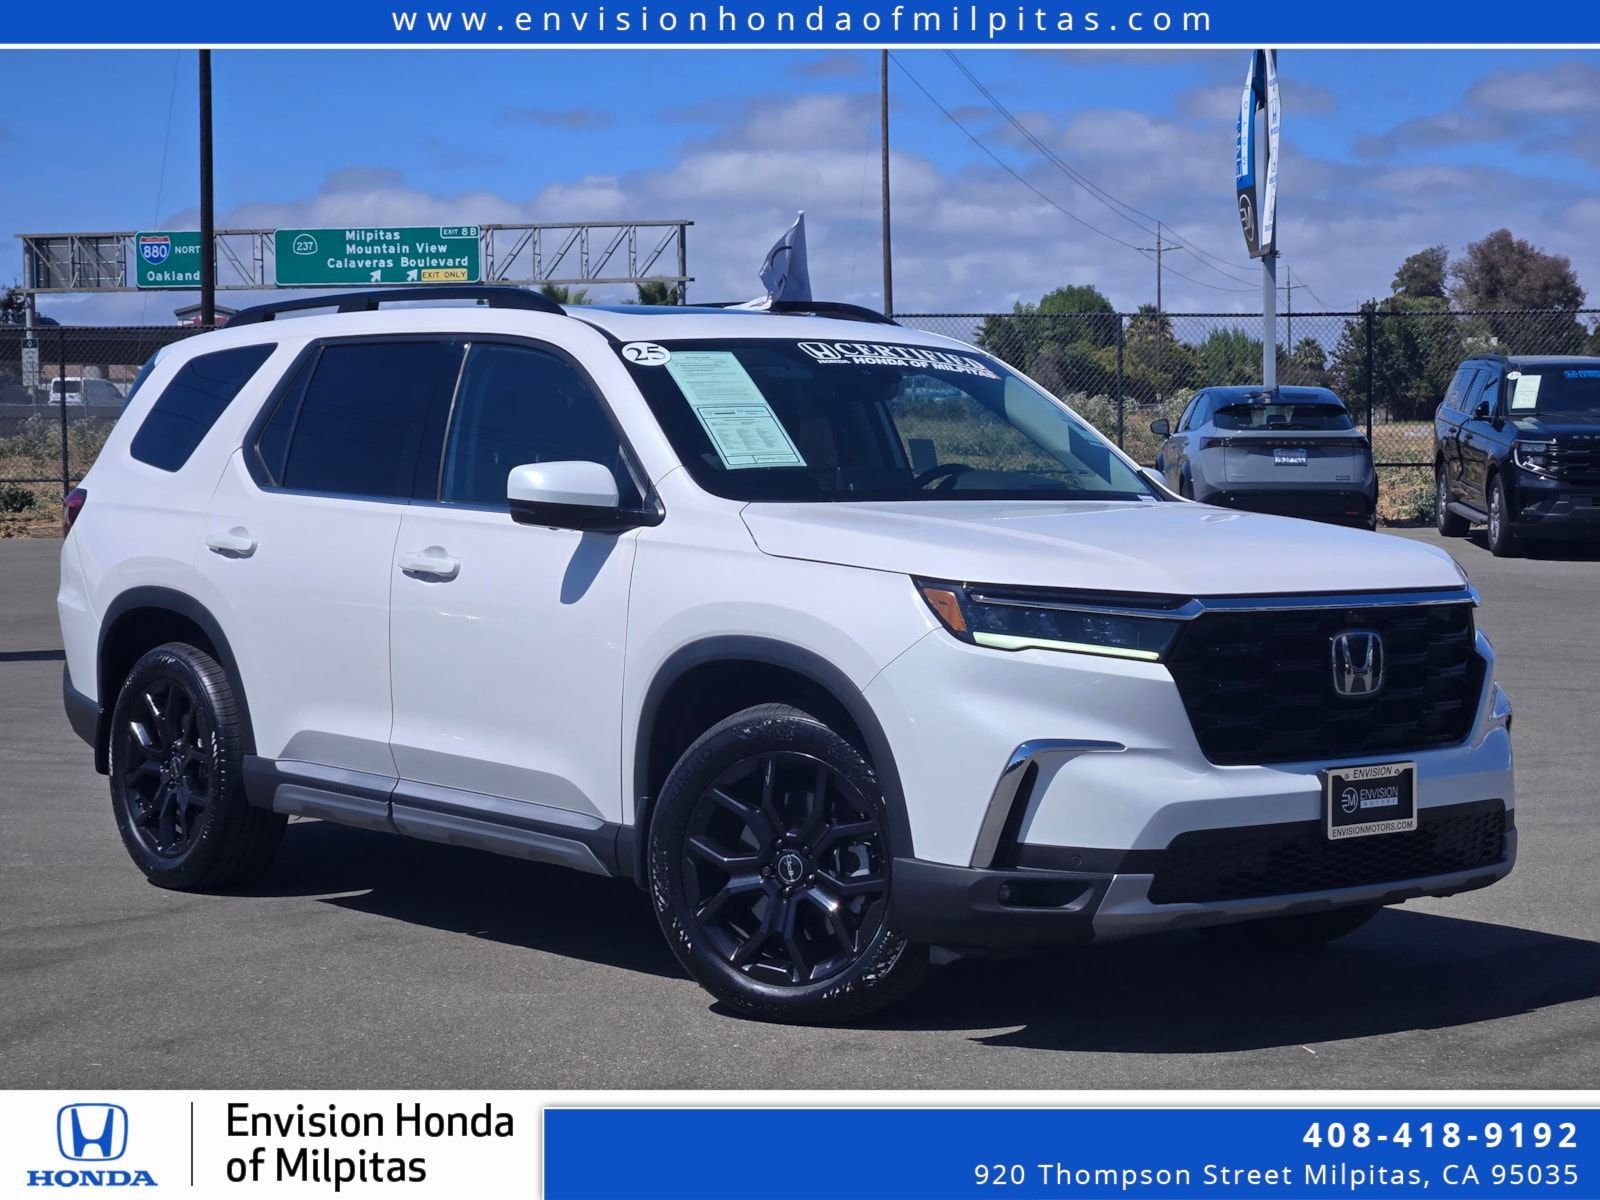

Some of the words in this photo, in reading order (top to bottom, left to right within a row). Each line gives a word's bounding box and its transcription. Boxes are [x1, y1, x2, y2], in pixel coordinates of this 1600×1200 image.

[345, 230, 400, 243] Milpitas
[143, 245, 167, 258] 880
[174, 246, 201, 254] NORT
[296, 242, 314, 251] 237
[346, 243, 410, 255] Mountain
[415, 242, 448, 253] View
[327, 257, 394, 269] Calaveras
[401, 255, 469, 267] Boulevard
[146, 270, 200, 281] Oakland
[422, 271, 440, 279] EXIT
[444, 271, 467, 279] ONLY
[626, 346, 666, 361] 25
[834, 342, 986, 370] CERTIFIED
[854, 356, 909, 367] HONDA
[909, 360, 928, 369] OF
[1353, 766, 1393, 779] ENVISION
[1360, 786, 1399, 800] ENVISION
[1332, 820, 1413, 838] ENVISIONMOTORS.COM
